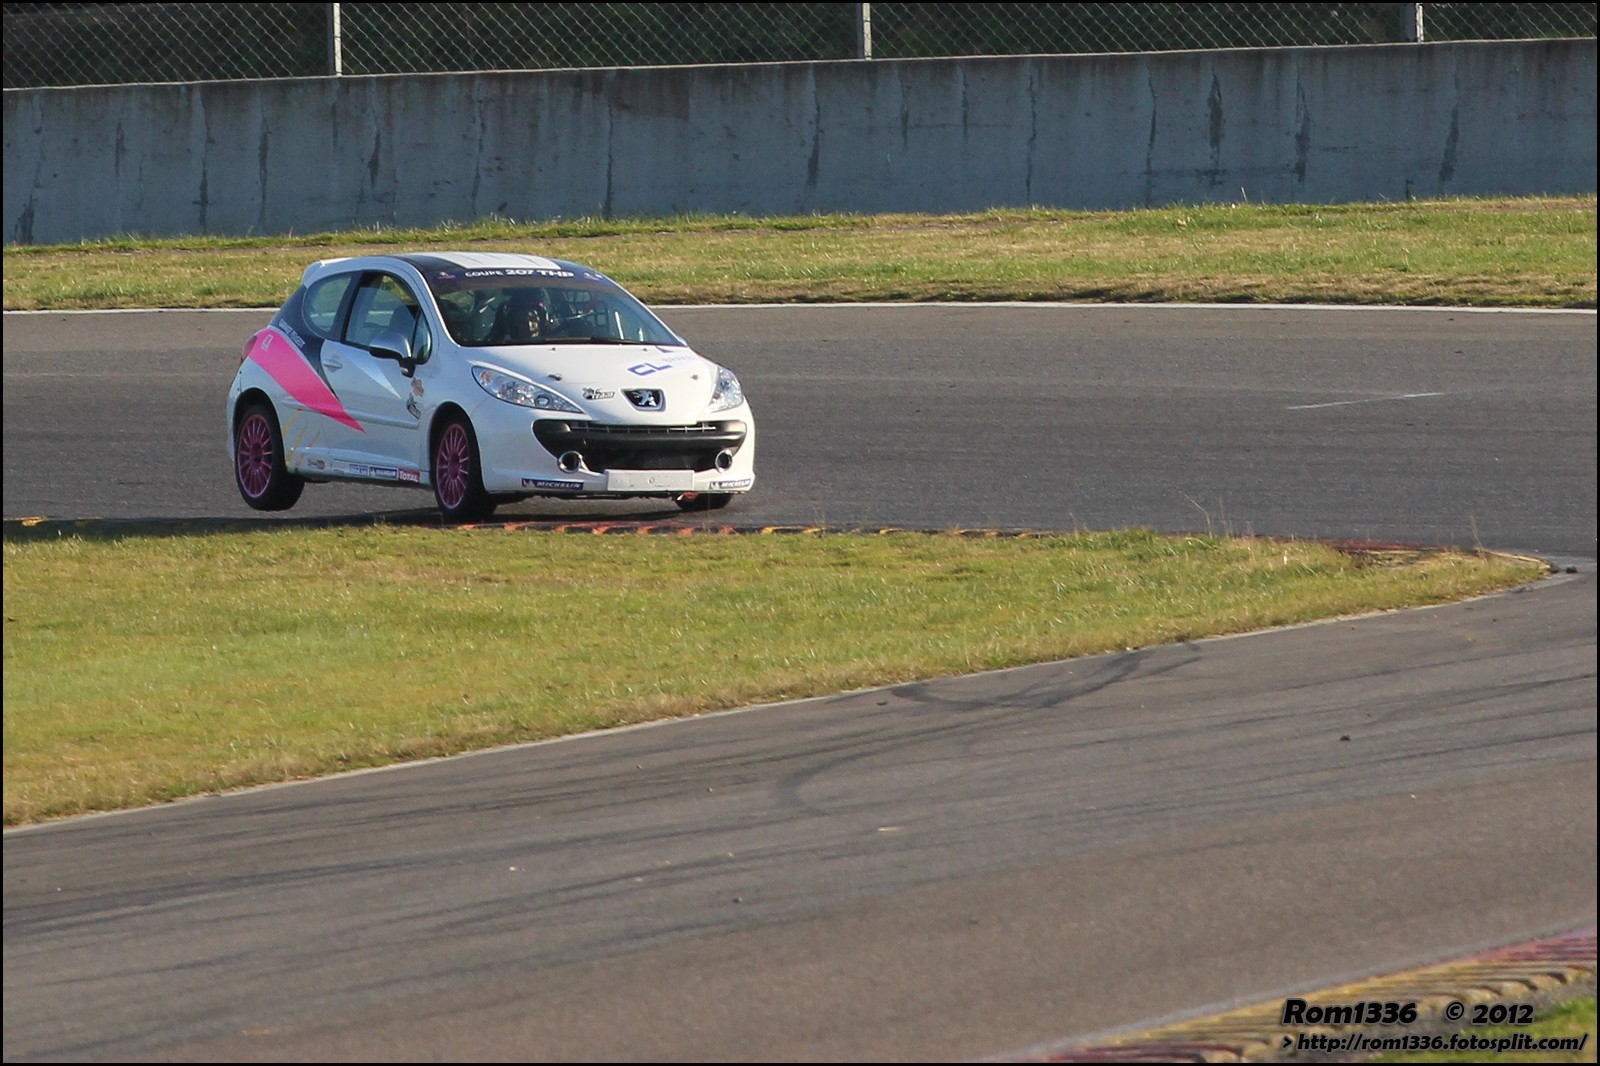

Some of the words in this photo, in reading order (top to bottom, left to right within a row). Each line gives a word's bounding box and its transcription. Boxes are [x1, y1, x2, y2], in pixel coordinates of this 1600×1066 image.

[537, 270, 574, 278] THP
[627, 362, 672, 376] CL
[399, 471, 419, 482] TOTAL
